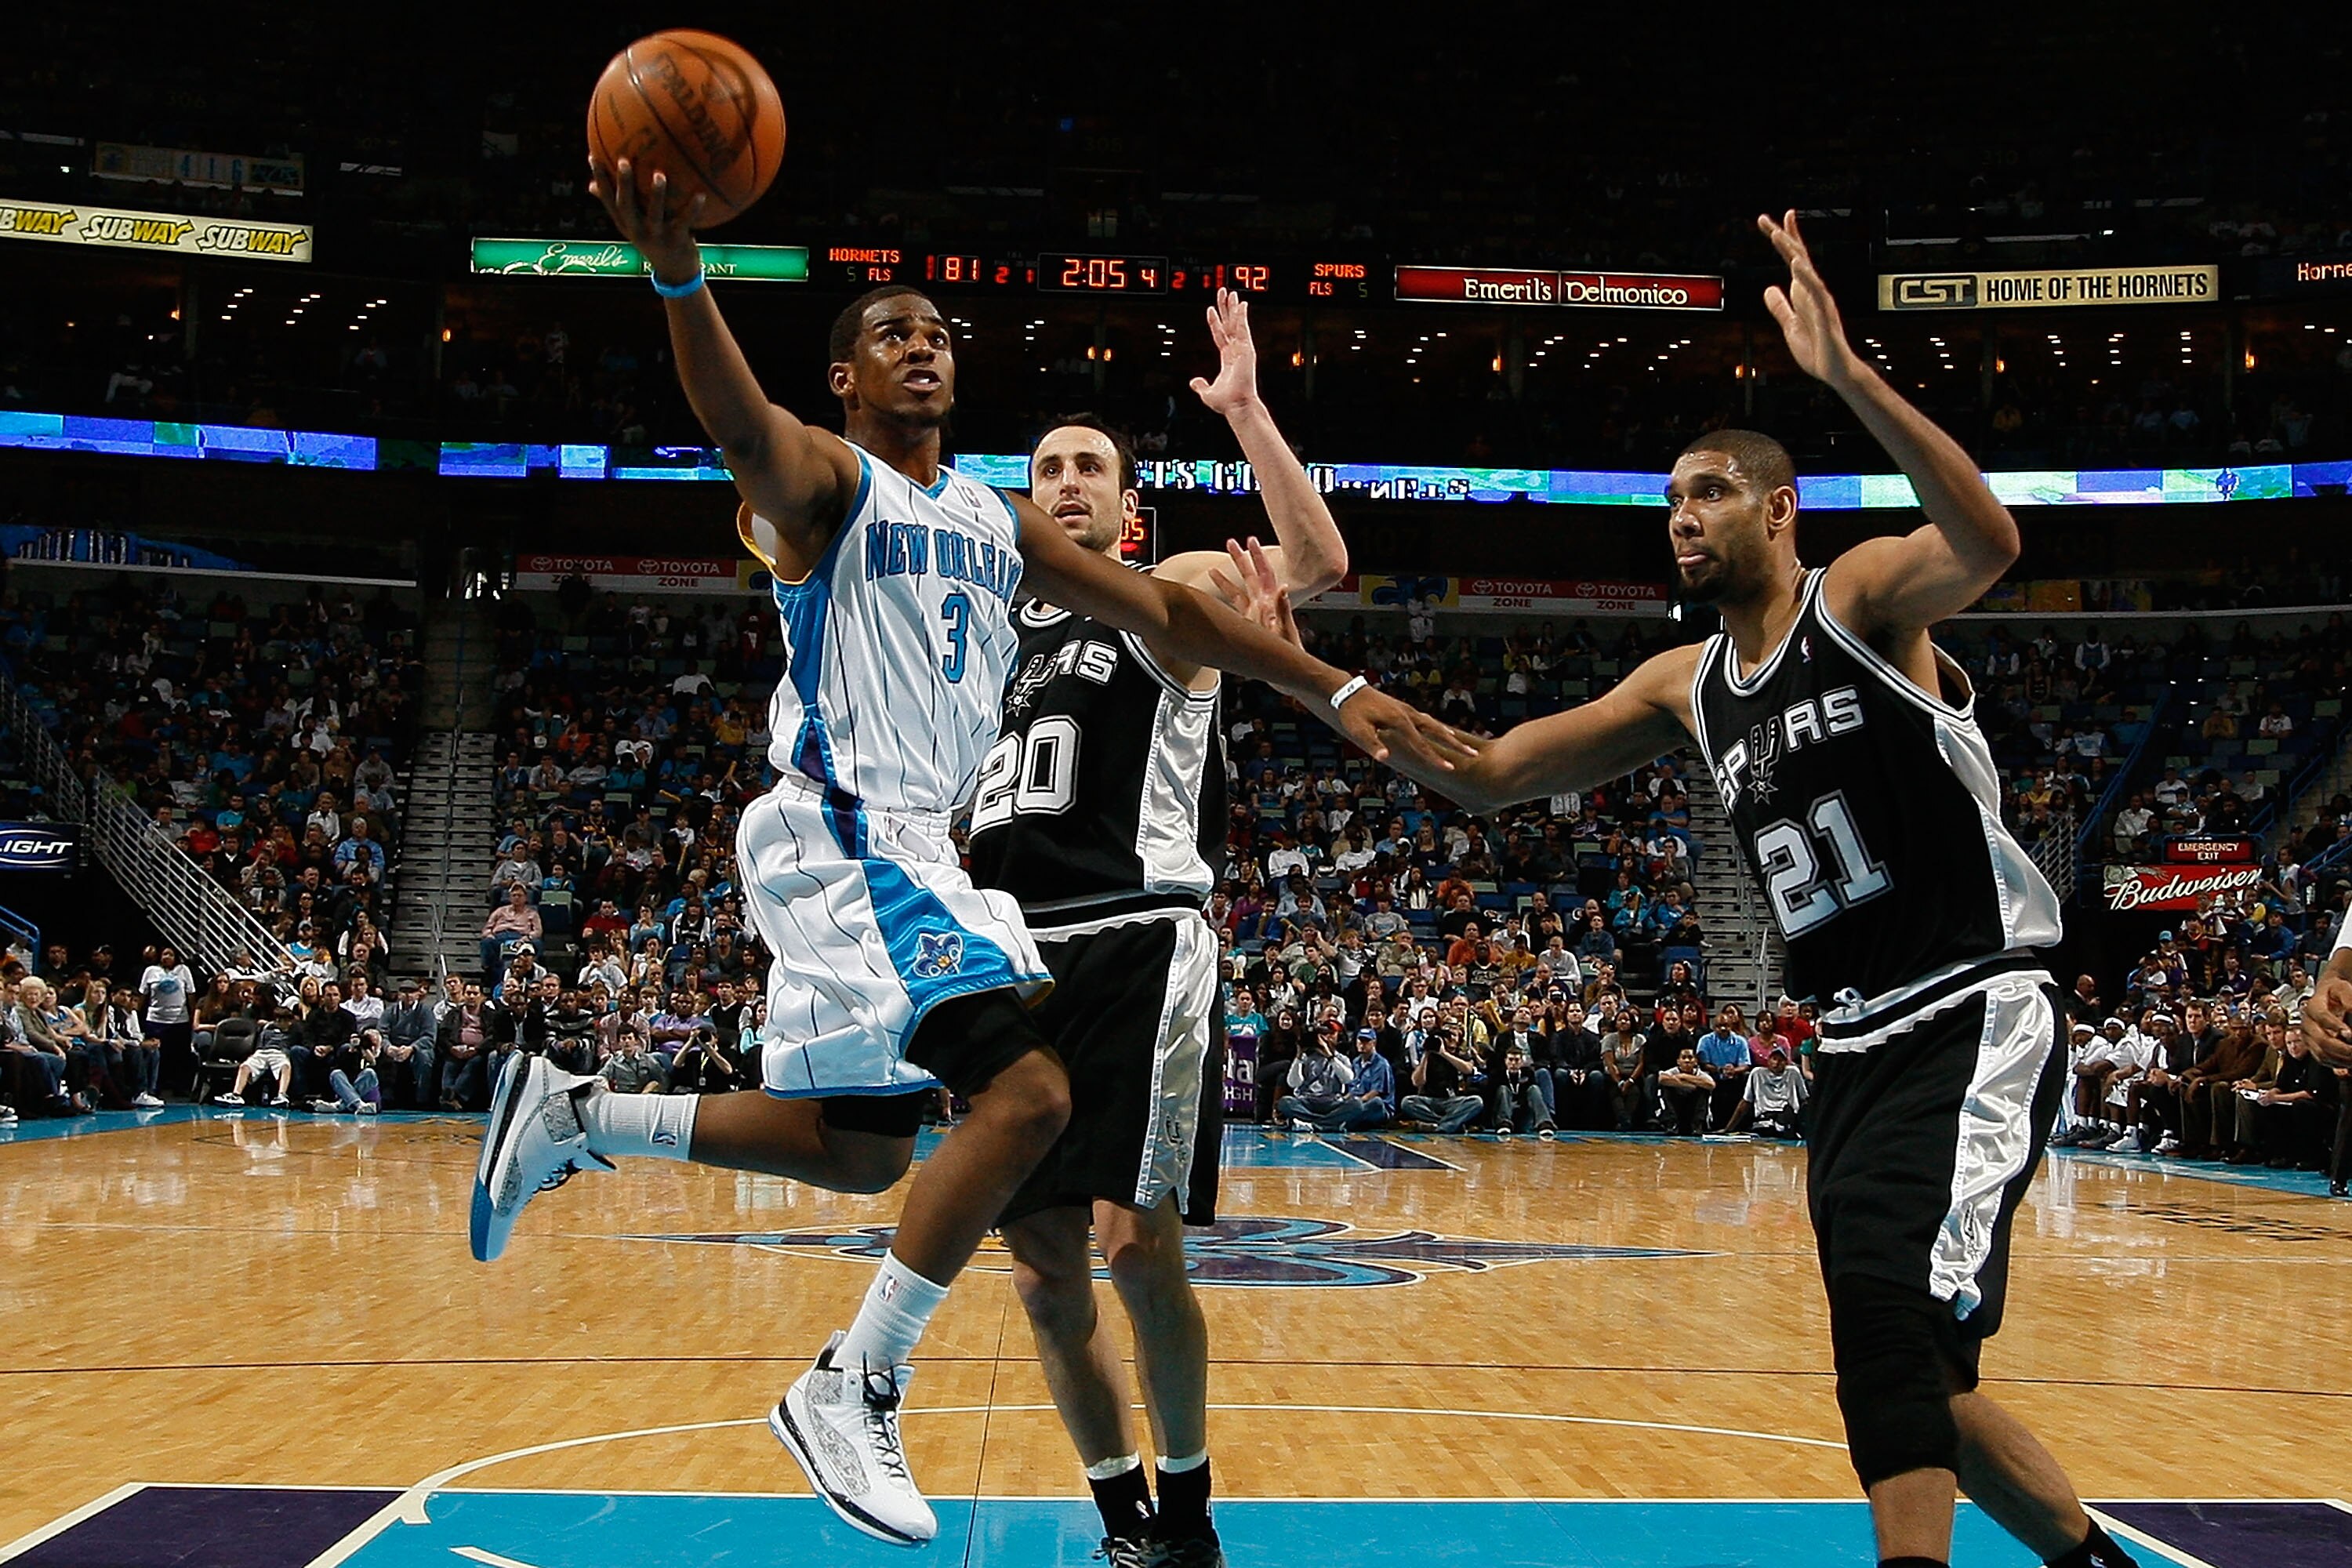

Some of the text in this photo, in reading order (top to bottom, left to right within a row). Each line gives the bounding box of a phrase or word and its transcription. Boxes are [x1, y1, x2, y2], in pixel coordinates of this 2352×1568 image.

[0, 209, 307, 255] BWAY SUBWAY SUBWAY
[539, 242, 627, 271] Emeril's
[829, 247, 900, 264] HORNETS
[867, 267, 892, 281] FLS
[946, 257, 978, 281] 81
[994, 267, 1011, 284] 2
[1062, 258, 1127, 289] 2:05
[1141, 268, 1156, 289] 4
[1171, 270, 1187, 289] 2
[1235, 266, 1268, 291] 92
[1313, 263, 1366, 279] SPURS
[1308, 281, 1334, 296] FLS
[1464, 278, 1553, 301] Emeril's
[1566, 277, 1688, 306] Delmonico
[1899, 277, 1975, 306] CST
[1987, 273, 2208, 303] HOME OF THE HORNETS
[866, 522, 928, 581] NEW
[660, 561, 721, 575] TOYOTA
[658, 577, 699, 588] ZONE
[1495, 581, 1553, 595] TOYOTA
[1597, 584, 1656, 598] TOYOTA
[1493, 597, 1532, 609] ZONE
[1596, 600, 1635, 612] ZONE
[941, 592, 971, 684] 3
[1716, 684, 1866, 814] SPURS
[970, 713, 1082, 840] 20
[0, 840, 73, 855] IGHT
[2177, 842, 2240, 852] EMERGENCY
[2197, 851, 2220, 861] EXIT
[1753, 789, 1896, 943] 21
[2104, 867, 2263, 910] Budweiser
